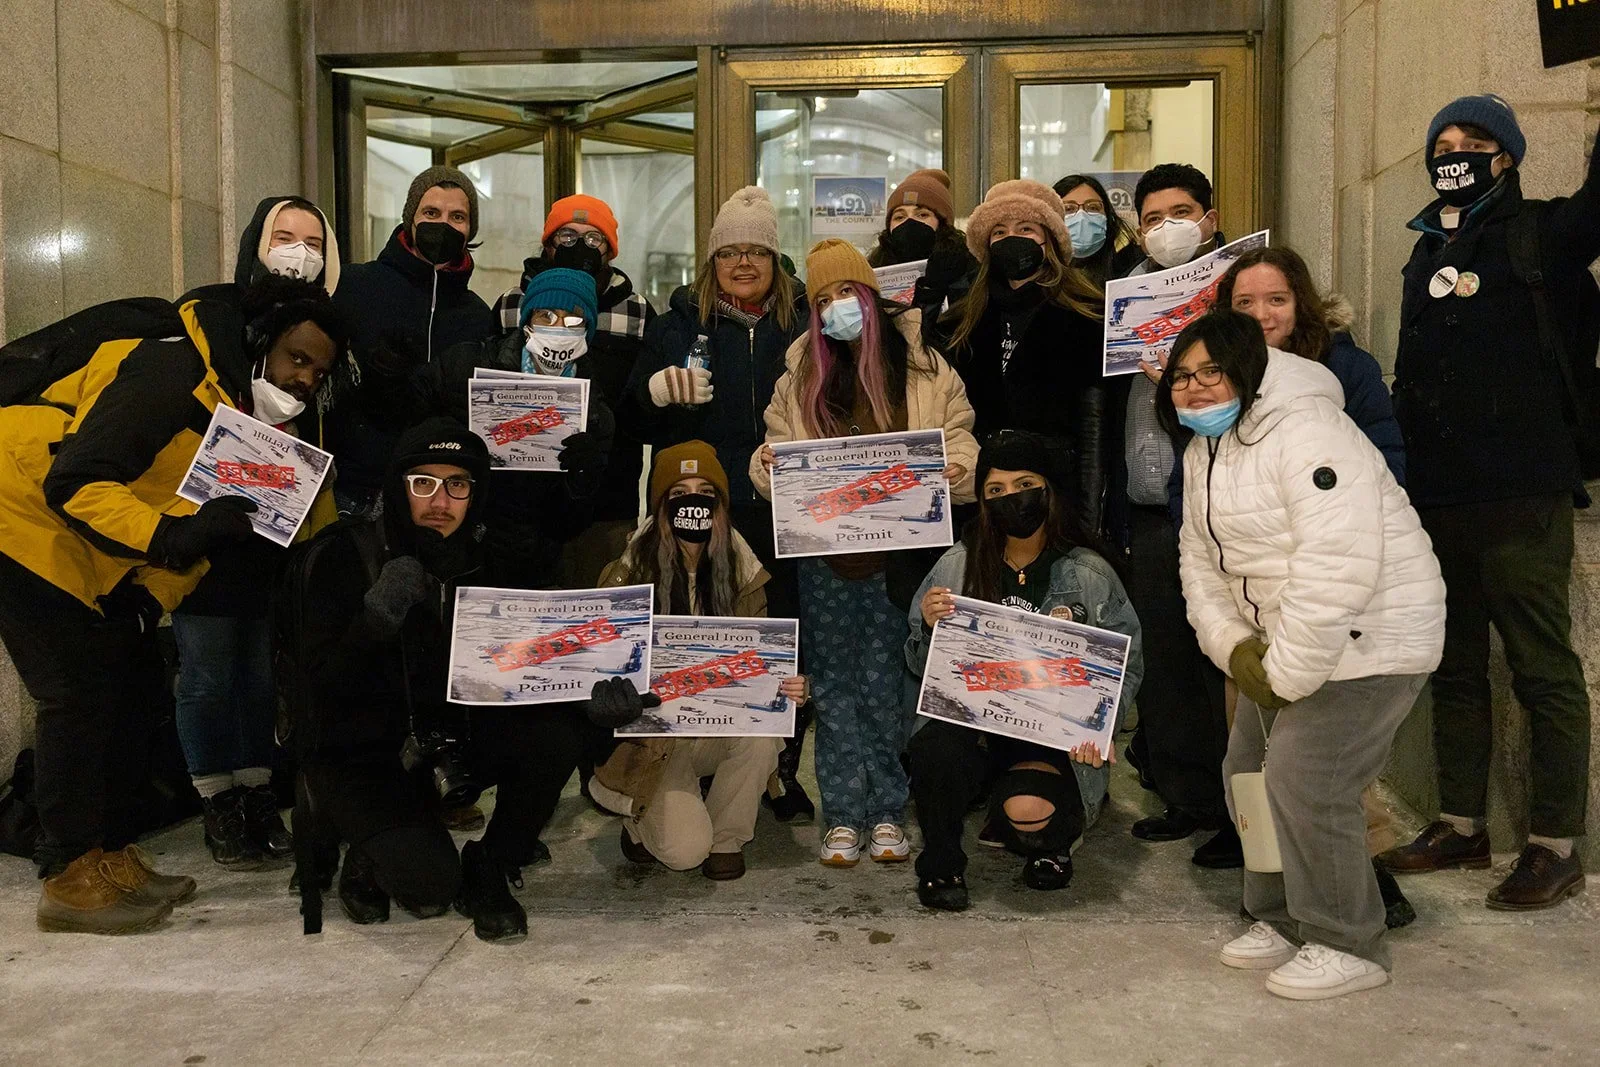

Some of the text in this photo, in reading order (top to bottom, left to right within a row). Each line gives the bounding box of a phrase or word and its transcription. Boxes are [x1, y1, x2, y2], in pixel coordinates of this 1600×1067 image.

[1437, 162, 1469, 177] STOP
[1163, 262, 1215, 286] Permit
[542, 347, 575, 361] STOP
[497, 392, 532, 400] General
[253, 429, 291, 455] Permit
[509, 454, 546, 463] Permit
[815, 449, 902, 463] General Iron
[677, 506, 710, 519] STOP
[673, 516, 699, 530] GENERAL
[835, 529, 894, 542] Permit
[507, 603, 604, 613] General Iron
[664, 632, 754, 642] General Iron
[1047, 634, 1080, 650] Iron
[517, 679, 584, 693] Permit
[676, 714, 735, 725] Permit
[982, 708, 1045, 732] Permit
